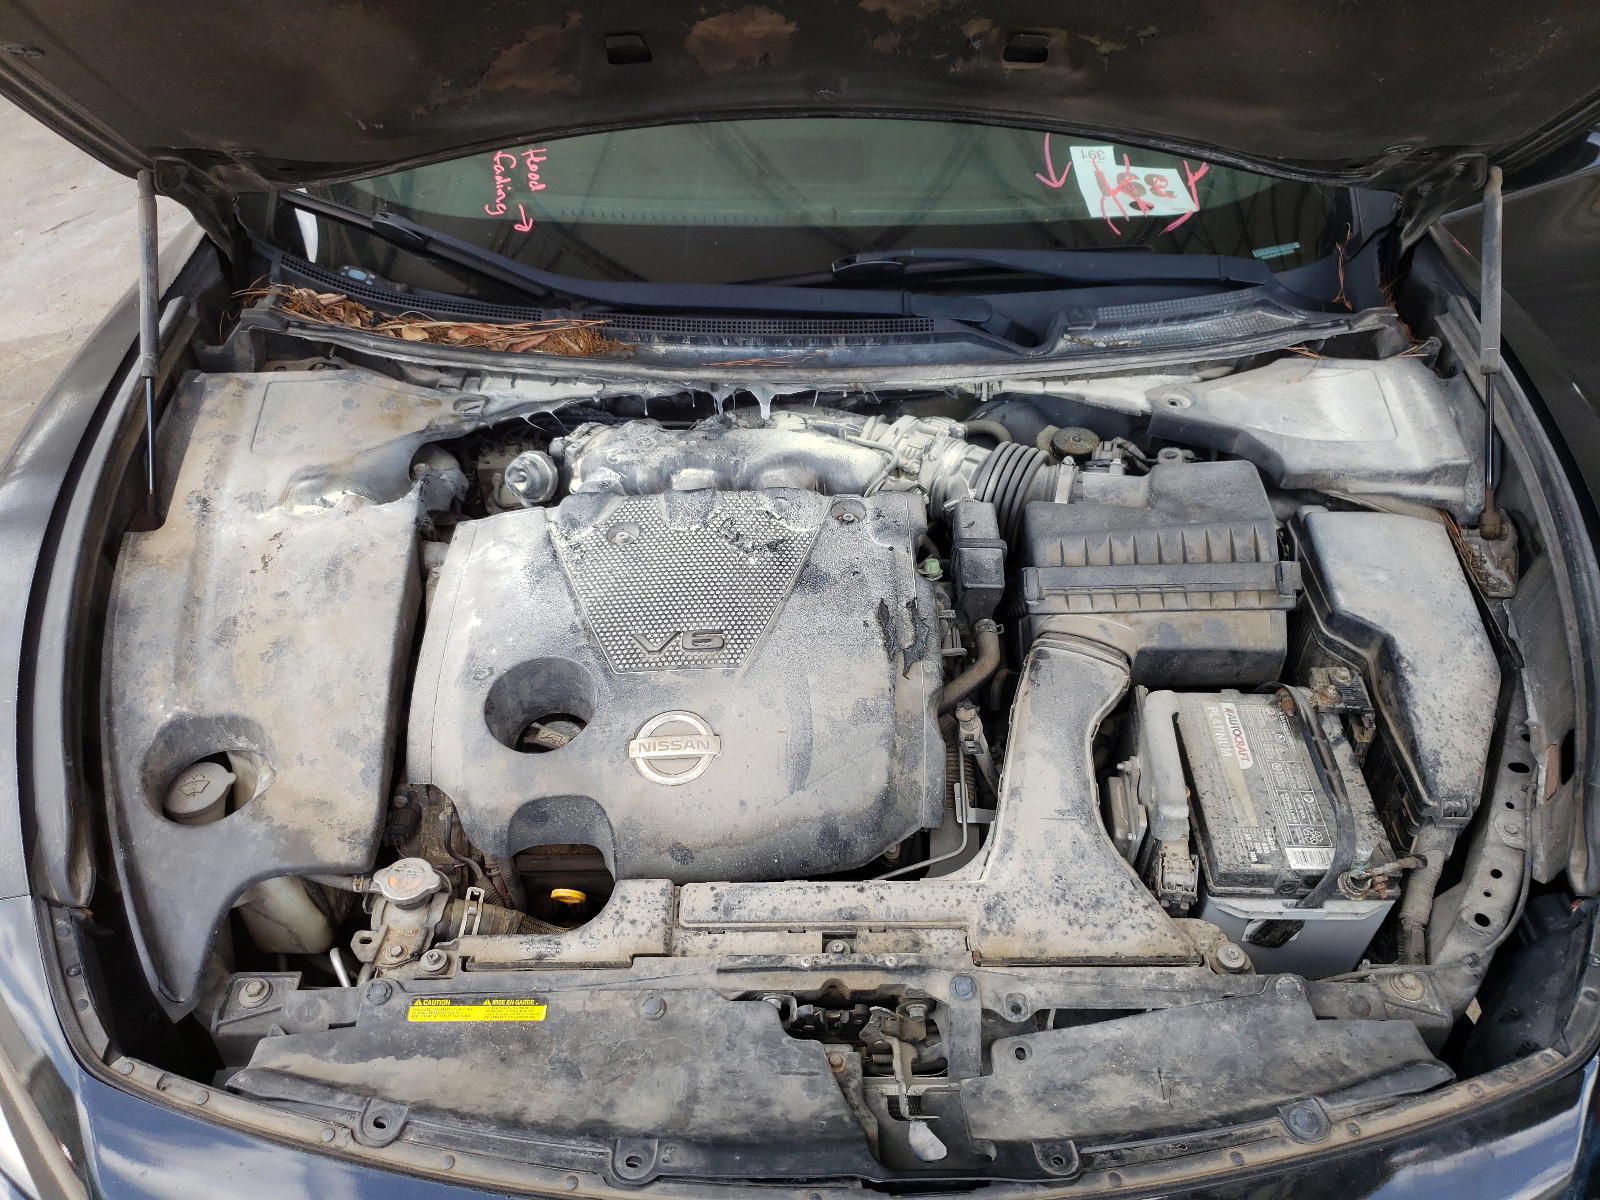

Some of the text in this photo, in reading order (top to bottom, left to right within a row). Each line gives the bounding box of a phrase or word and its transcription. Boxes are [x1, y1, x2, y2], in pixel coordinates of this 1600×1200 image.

[630, 629, 725, 654] V6
[638, 739, 710, 752] NISSAN
[1207, 706, 1233, 757] PLATINUM
[1225, 711, 1250, 762] AUTOCRAFT
